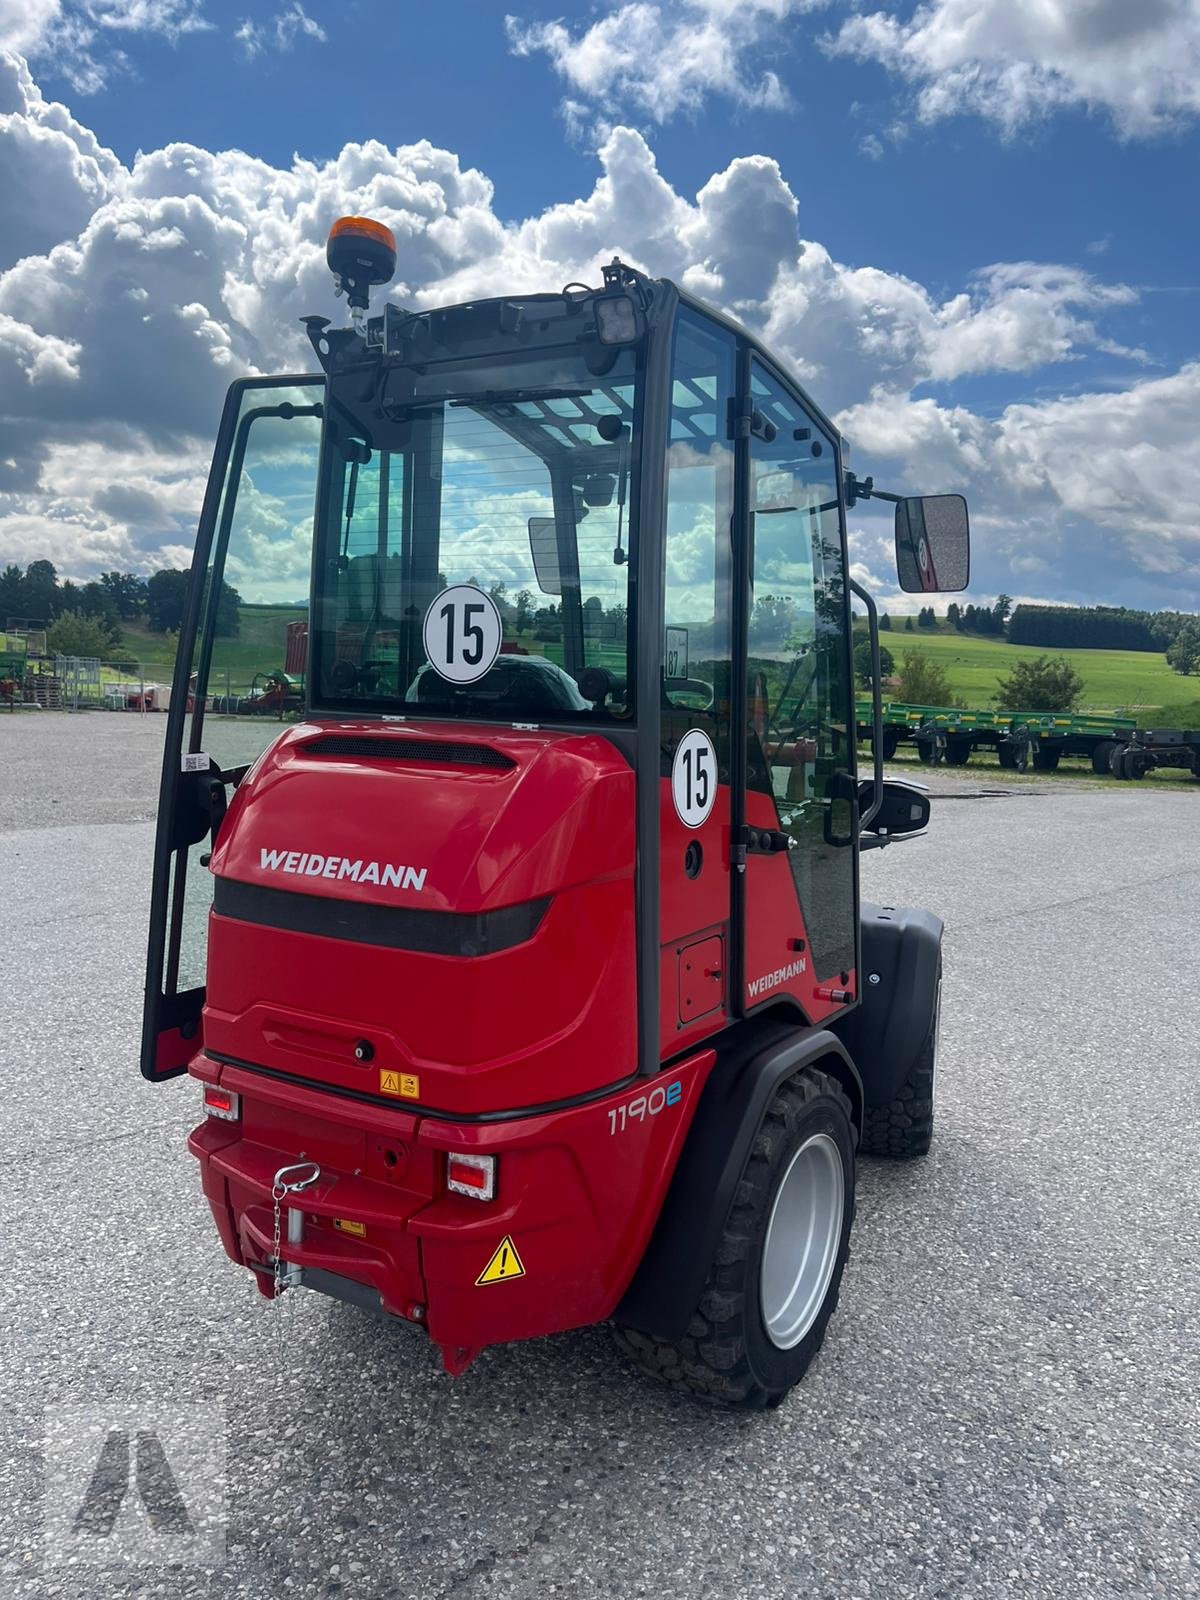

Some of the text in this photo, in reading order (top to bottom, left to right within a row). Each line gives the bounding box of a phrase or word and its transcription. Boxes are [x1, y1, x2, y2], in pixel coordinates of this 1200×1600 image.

[440, 603, 485, 665] 15
[683, 747, 708, 810] 15
[260, 848, 428, 891] WEIDEMANN
[748, 958, 806, 998] WEIDEMANN
[608, 1081, 681, 1136] 1190e
